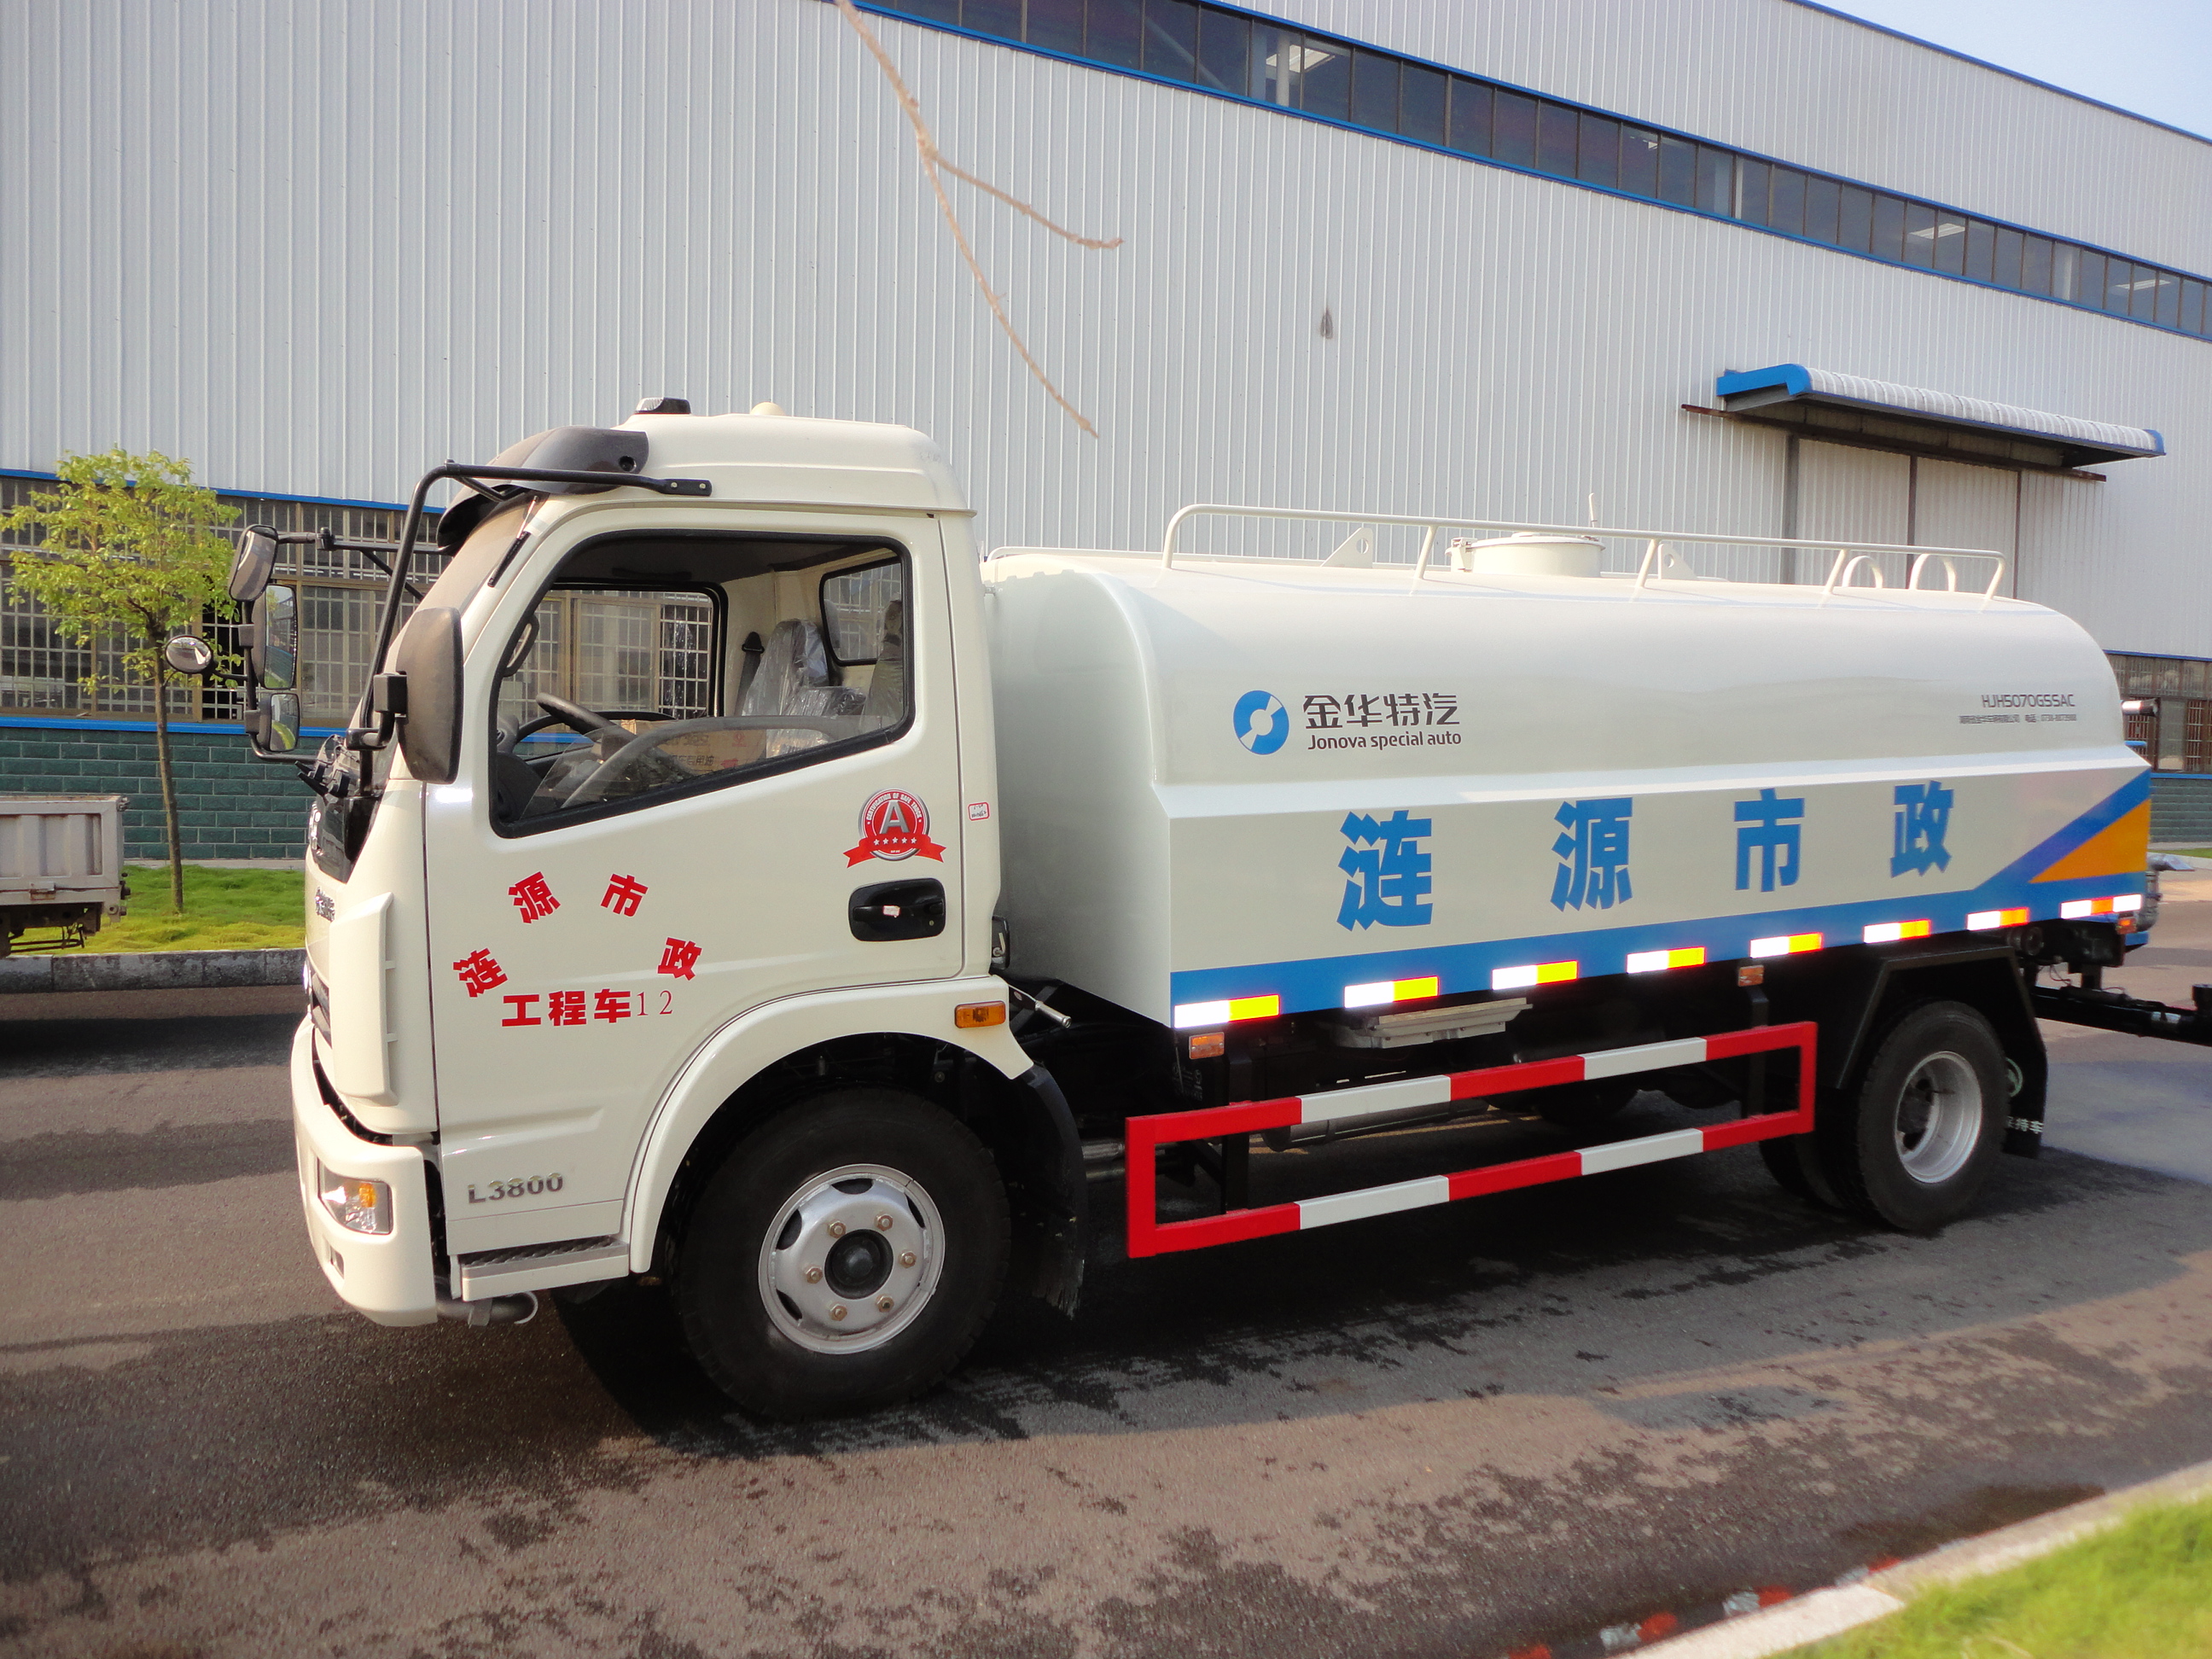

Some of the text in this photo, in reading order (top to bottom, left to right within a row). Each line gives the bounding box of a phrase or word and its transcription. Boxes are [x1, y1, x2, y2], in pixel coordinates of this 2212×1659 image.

[1303, 693, 1460, 729] 金华特汽
[1307, 731, 1462, 751] Jonova special auto
[879, 800, 911, 835] A
[900, 794, 912, 804] SAFE
[911, 801, 923, 819] TRUCK
[1337, 781, 1954, 930] 涟源市政
[452, 871, 702, 998] 涟源市政
[468, 1173, 563, 1204] L3800
